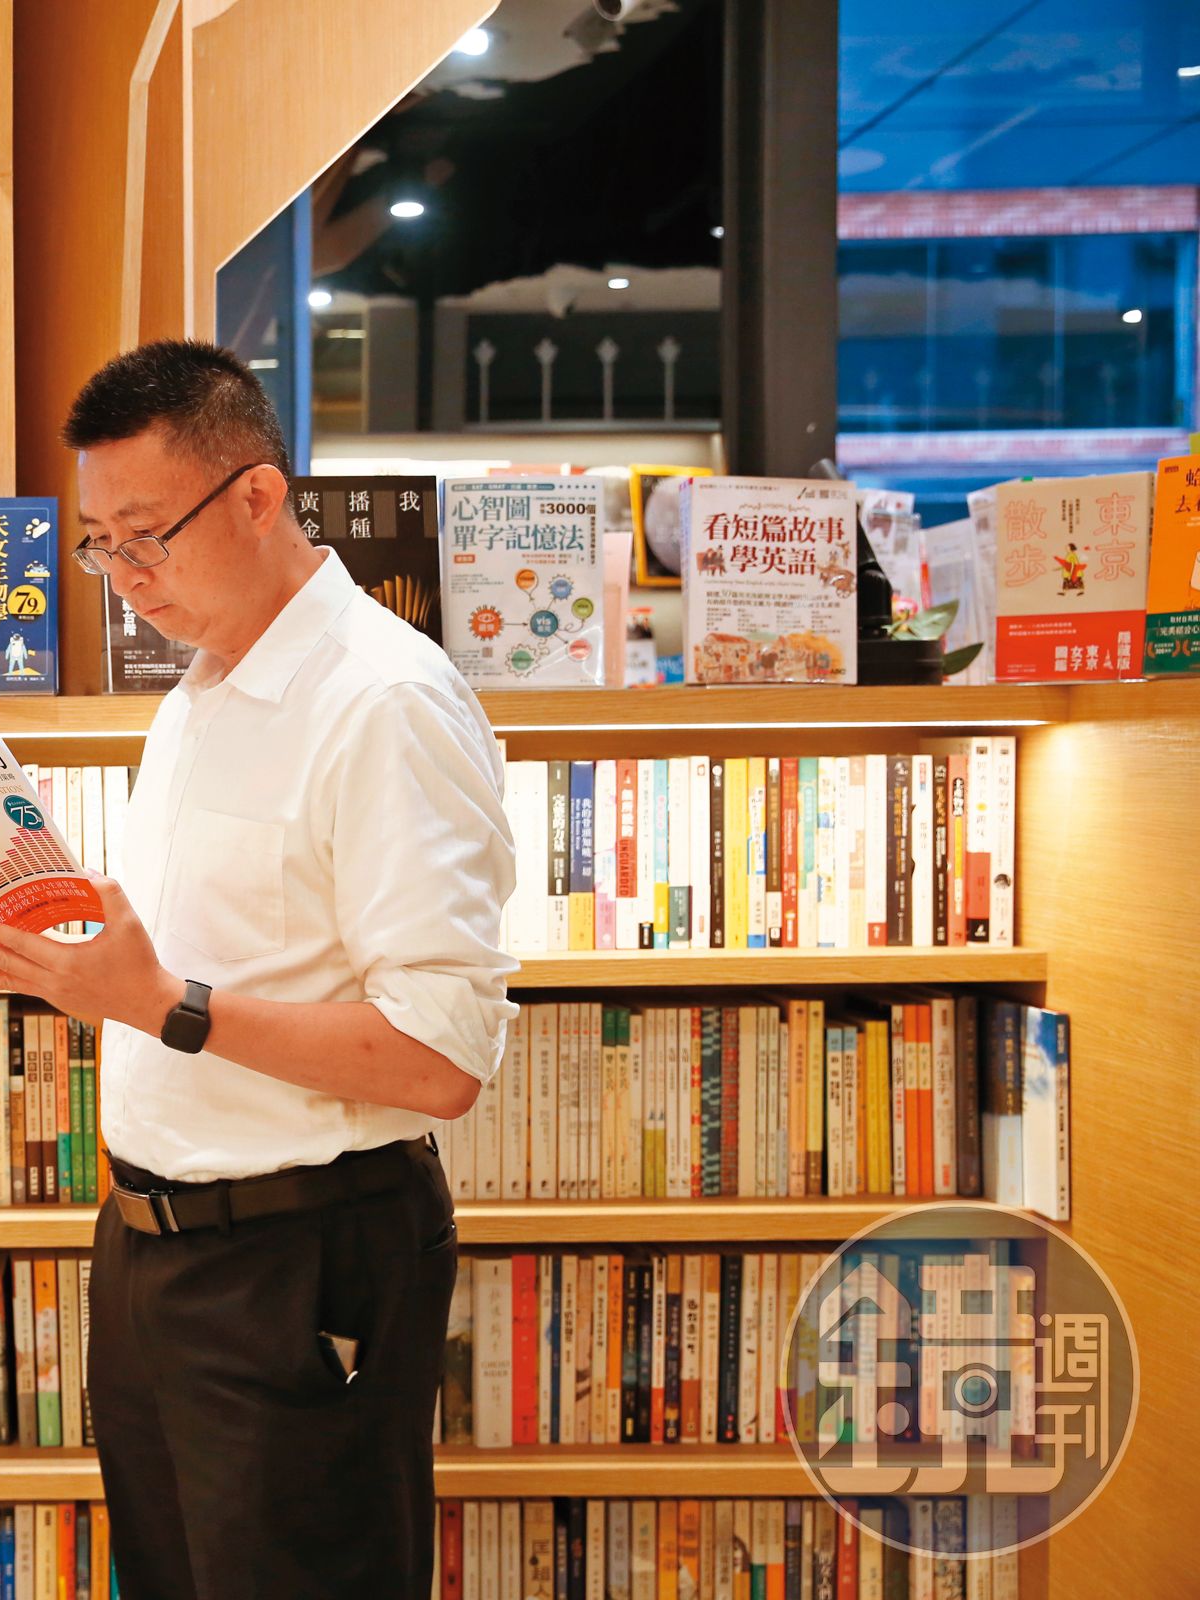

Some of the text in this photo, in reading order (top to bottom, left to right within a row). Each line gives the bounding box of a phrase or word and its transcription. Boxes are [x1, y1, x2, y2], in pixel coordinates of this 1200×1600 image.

[298, 491, 320, 539] 黃金
[349, 491, 371, 539] 播種
[400, 491, 420, 512] 我
[451, 495, 530, 522] 心智圖
[451, 524, 584, 551] 單字記憶法
[703, 513, 845, 544] 看短篇故事
[1004, 500, 1047, 588] 散步
[1094, 492, 1136, 581] 東京
[730, 547, 816, 576] 學英語
